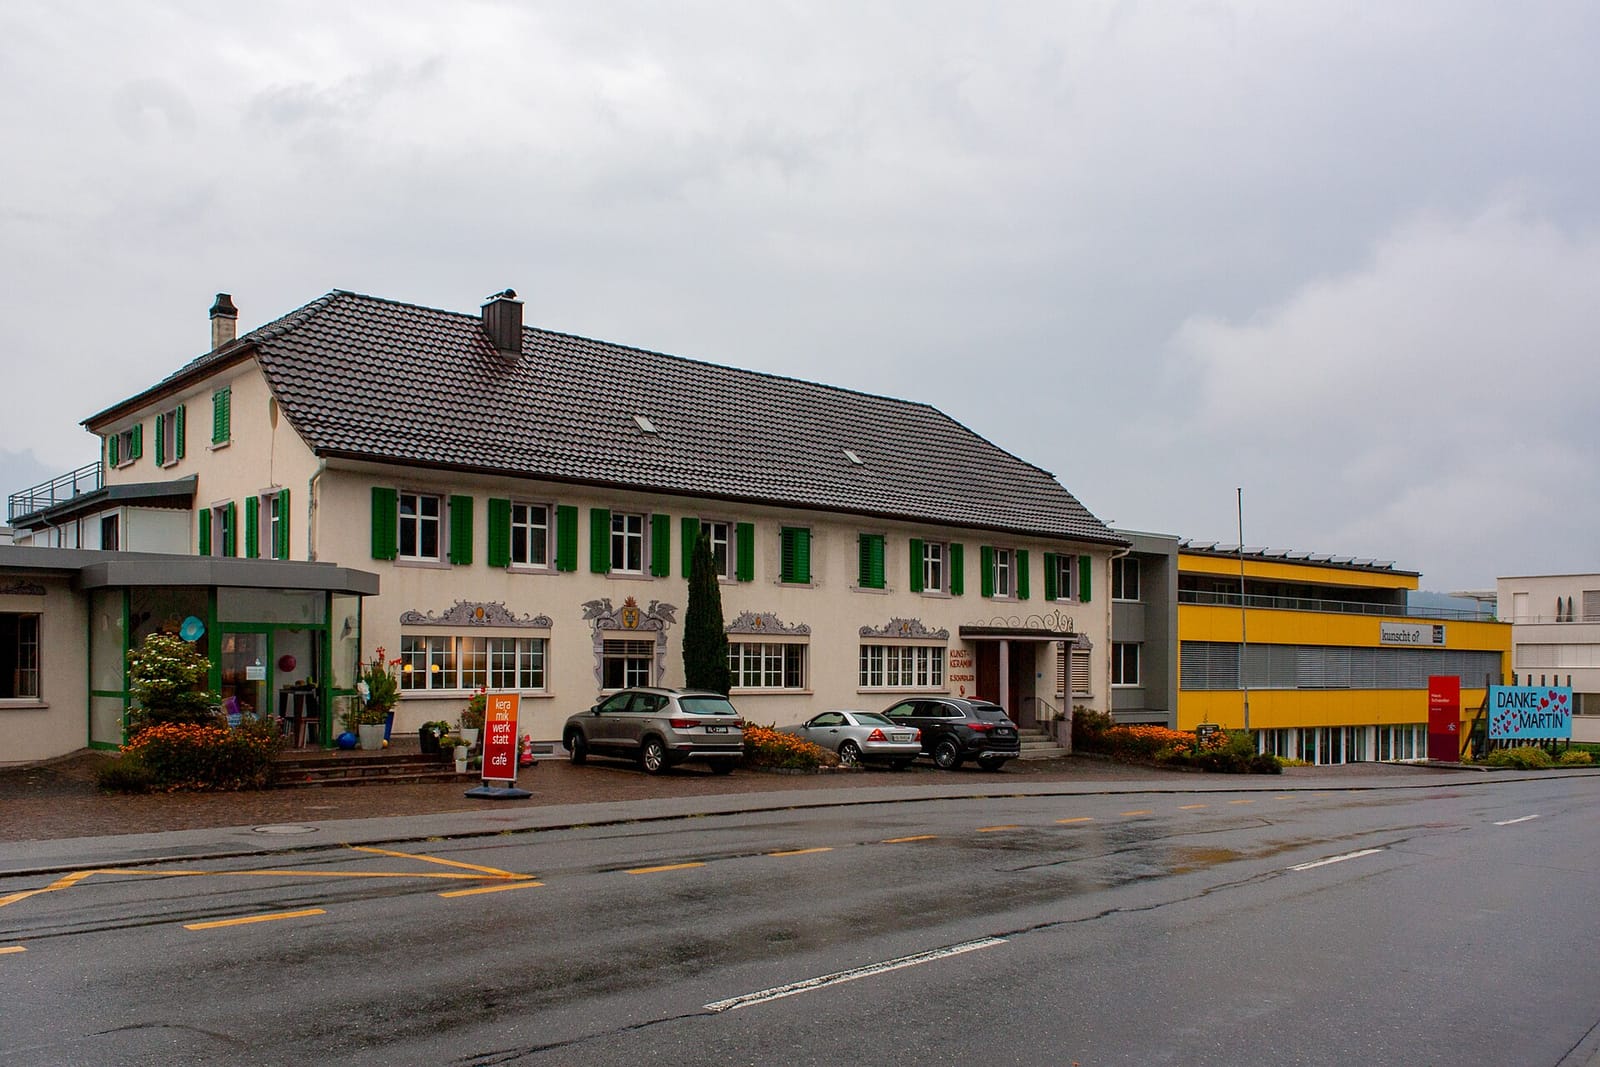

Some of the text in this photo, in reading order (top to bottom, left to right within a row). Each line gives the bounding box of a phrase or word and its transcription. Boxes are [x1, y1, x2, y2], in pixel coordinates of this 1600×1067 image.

[1382, 629, 1410, 642] kunscht
[1411, 630, 1420, 642] o?
[495, 698, 511, 710] kera
[1497, 692, 1537, 708] DANKE
[495, 710, 509, 721] mik
[1519, 713, 1563, 728] MARTIN
[492, 722, 510, 733] werk
[492, 735, 509, 745] statt
[491, 752, 507, 765] café
